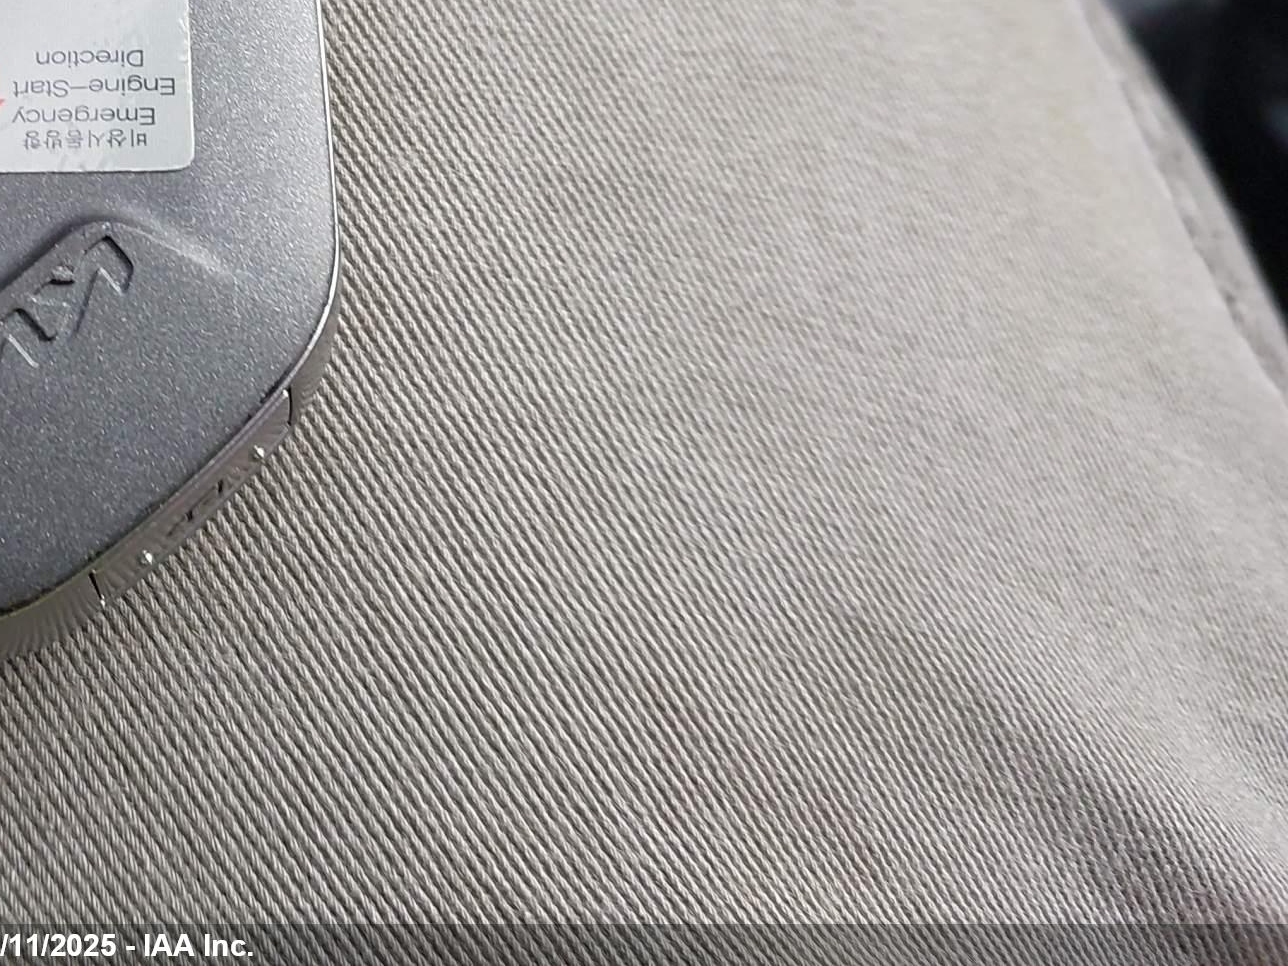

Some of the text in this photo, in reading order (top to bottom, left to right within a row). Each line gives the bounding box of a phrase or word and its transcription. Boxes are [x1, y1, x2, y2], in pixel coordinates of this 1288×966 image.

[35, 49, 145, 67] Direction
[11, 105, 156, 125] Emergency
[22, 128, 148, 150] 비상시동방향
